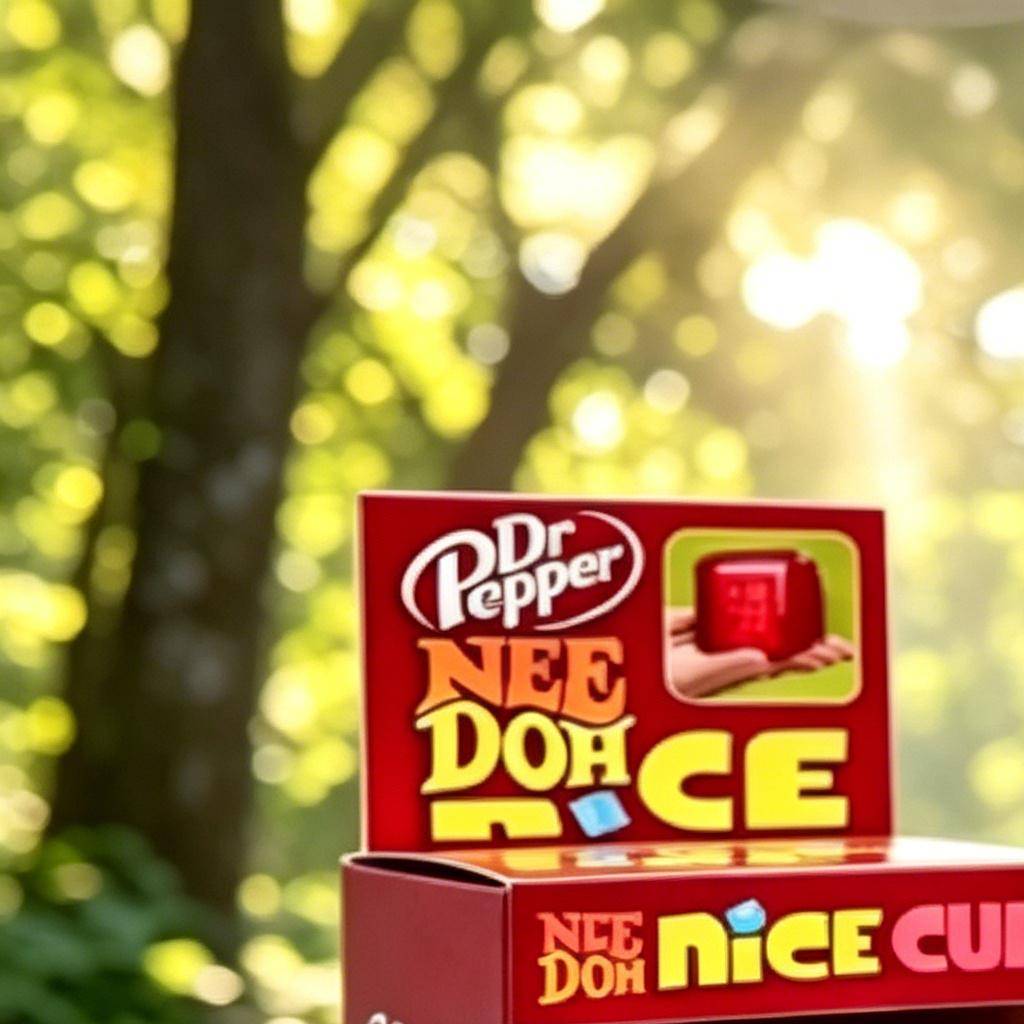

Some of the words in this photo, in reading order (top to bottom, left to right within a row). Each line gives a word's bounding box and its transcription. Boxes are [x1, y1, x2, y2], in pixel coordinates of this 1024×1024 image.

[434, 529, 625, 631] Pepper
[491, 512, 576, 577] Dr
[415, 636, 627, 725] NEE
[415, 698, 637, 795] DOH
[537, 950, 646, 1006] DOH
